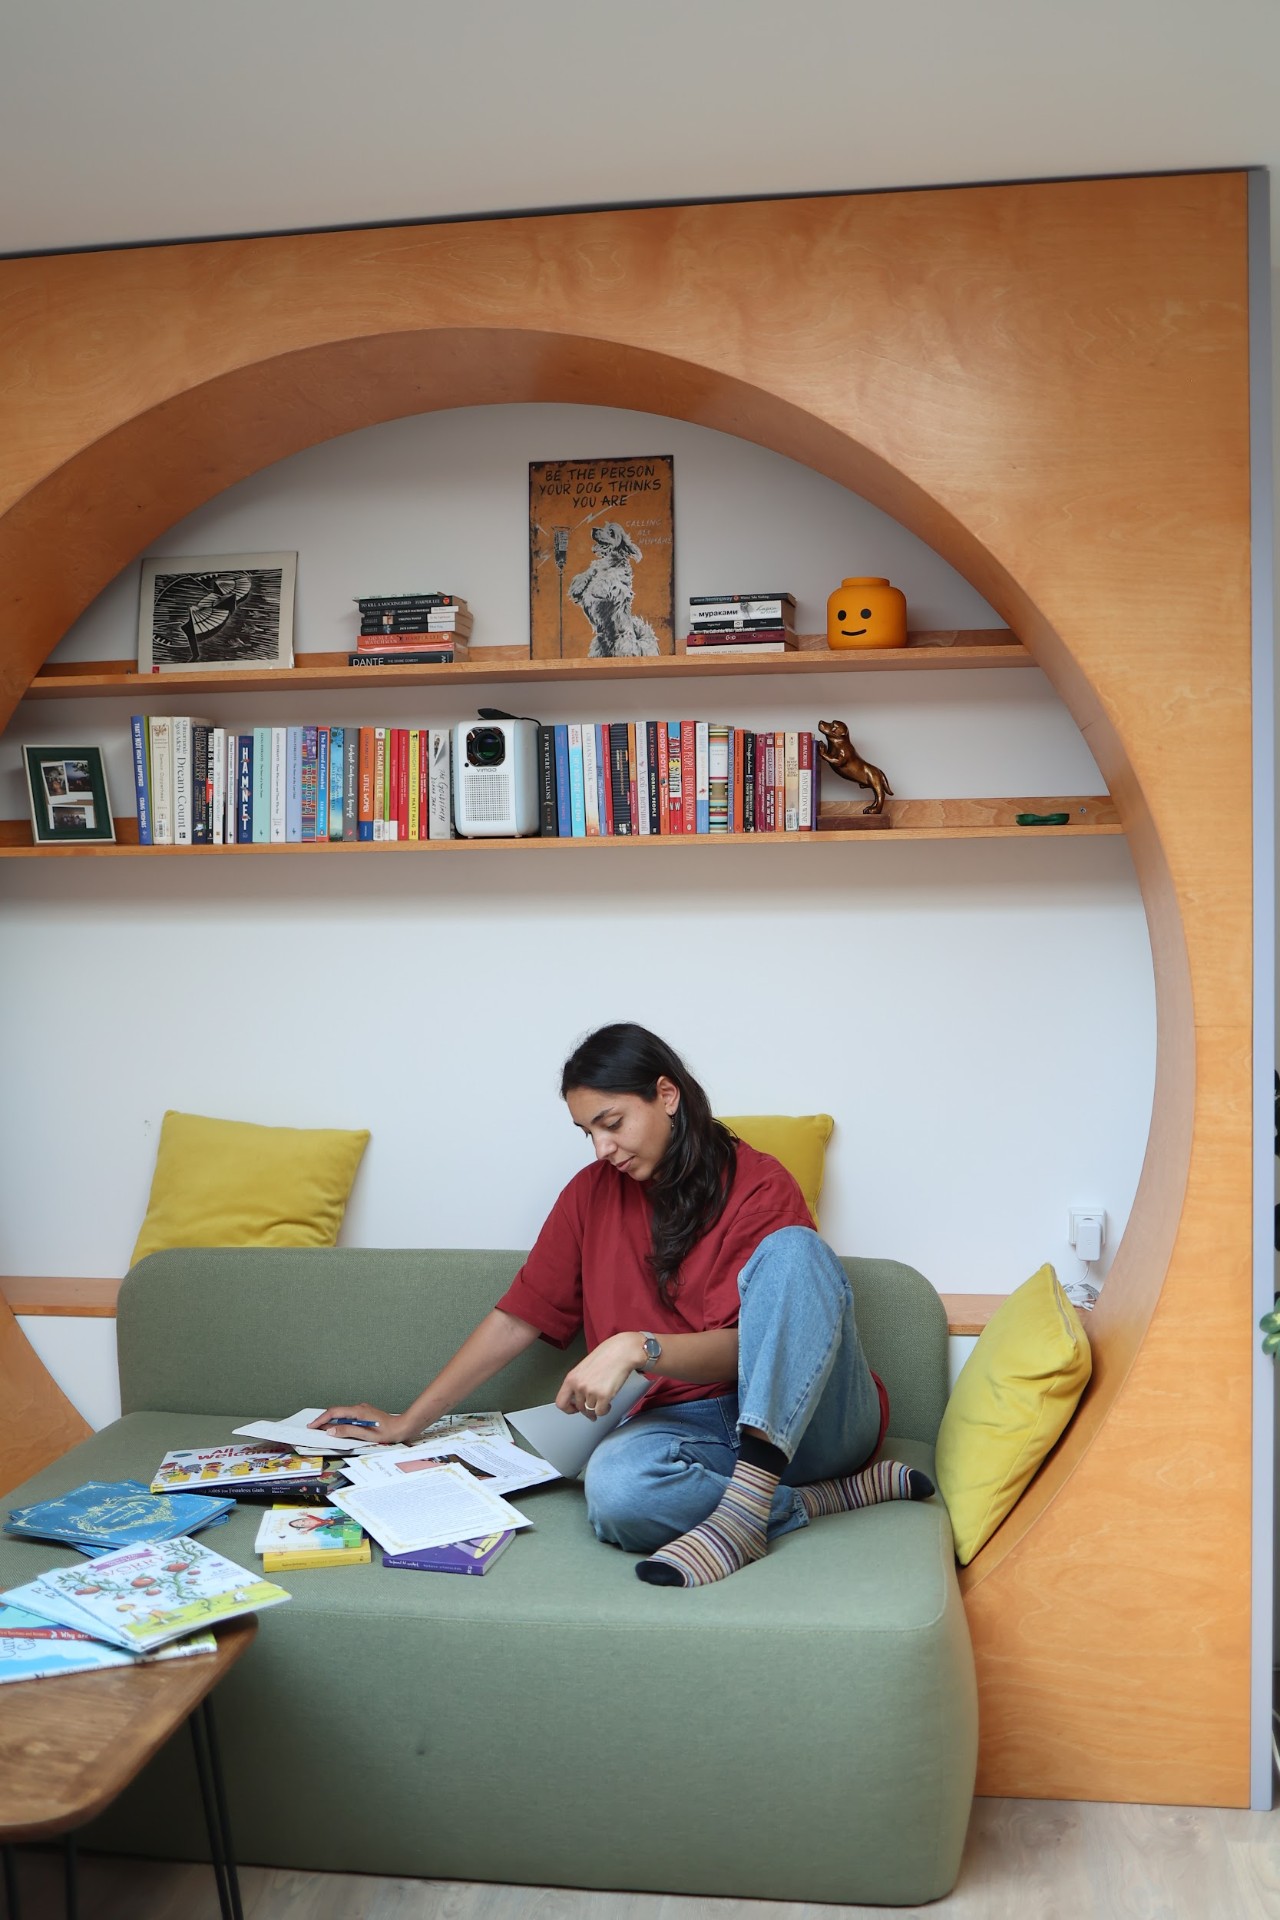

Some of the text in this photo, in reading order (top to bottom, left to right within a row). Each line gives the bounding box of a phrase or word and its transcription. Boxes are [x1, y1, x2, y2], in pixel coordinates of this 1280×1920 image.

[545, 465, 655, 482] BE THE PERSON
[539, 478, 661, 495] YOUR DOG THINKS
[572, 495, 628, 508] YOU ARE
[625, 519, 662, 527] CALLING
[698, 610, 738, 618] мураками
[353, 657, 384, 667] DANTE
[544, 741, 550, 751] WE
[683, 726, 692, 750] ANXIOUS
[376, 741, 384, 798] ECKHART TOLLE
[684, 751, 693, 771] PEOPLE
[241, 747, 250, 831] HAMNET
[669, 766, 681, 792] SMITH
[177, 757, 187, 828] Dream Count
[801, 772, 809, 807] DANDELION
[685, 796, 694, 821] BACKMAN
[100, 1555, 165, 1577] WORRY
[60, 1631, 75, 1640] Why
